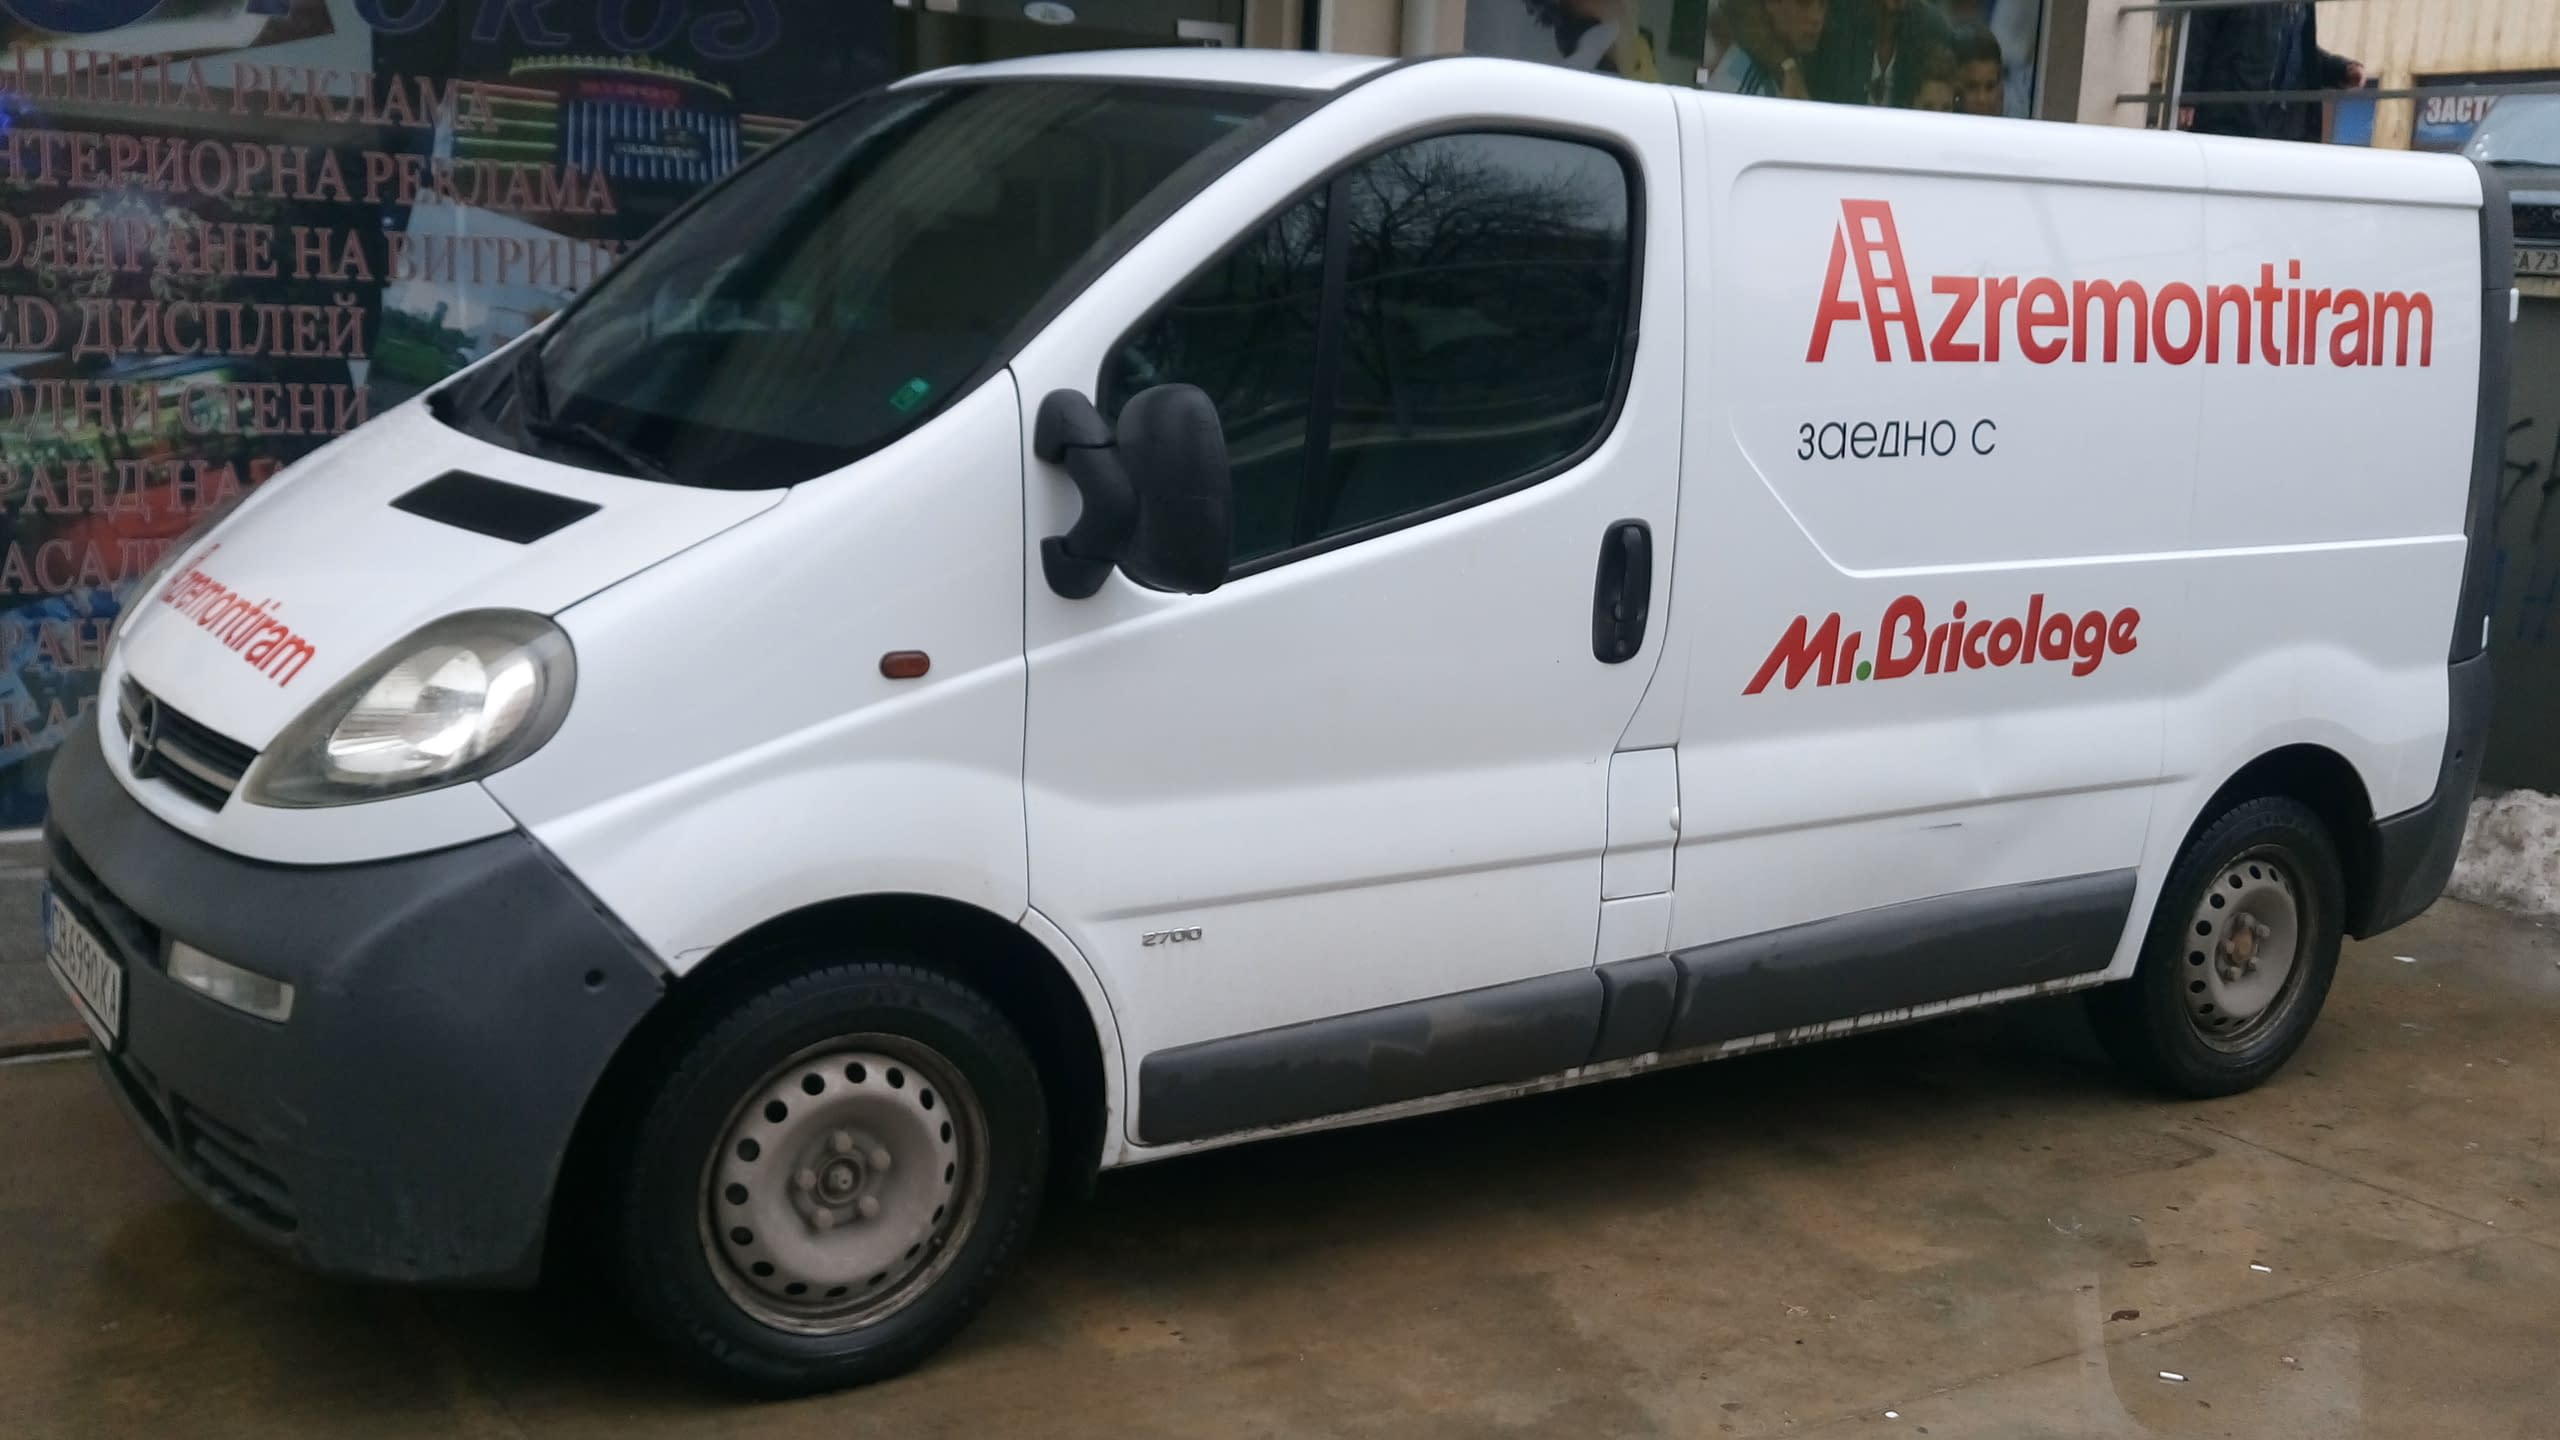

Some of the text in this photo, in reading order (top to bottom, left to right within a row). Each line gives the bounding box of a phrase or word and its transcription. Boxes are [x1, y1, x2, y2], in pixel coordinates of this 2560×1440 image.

[232, 60, 499, 132] РЕКЛАМА
[361, 150, 617, 215] РЕКЛАМА
[291, 227, 373, 281] НА
[1805, 198, 2433, 367] Azremontiram
[72, 291, 366, 362] ДИСПЛЕЙ
[179, 380, 369, 437] СТЕНИ
[1797, 418, 1997, 460] заедно с
[1142, 926, 1203, 948] 2700
